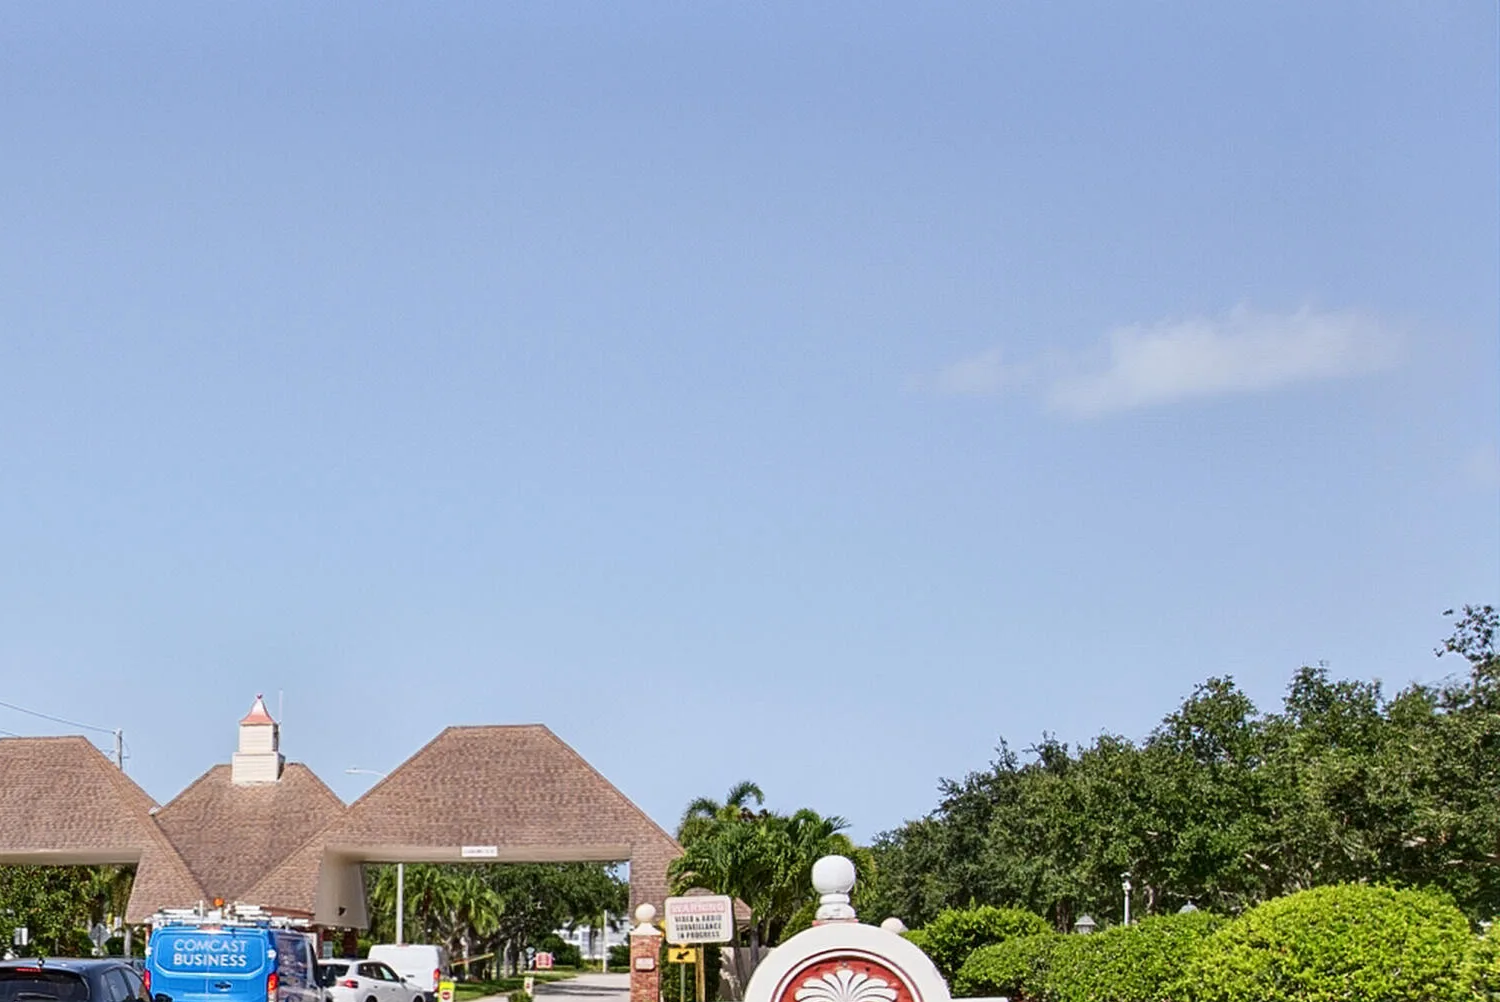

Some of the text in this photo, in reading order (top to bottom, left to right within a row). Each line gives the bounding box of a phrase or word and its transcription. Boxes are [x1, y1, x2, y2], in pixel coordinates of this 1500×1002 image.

[676, 923, 722, 931] SURVEILLANCE
[173, 939, 248, 952] COMCAST
[173, 953, 247, 967] BUSINESS
